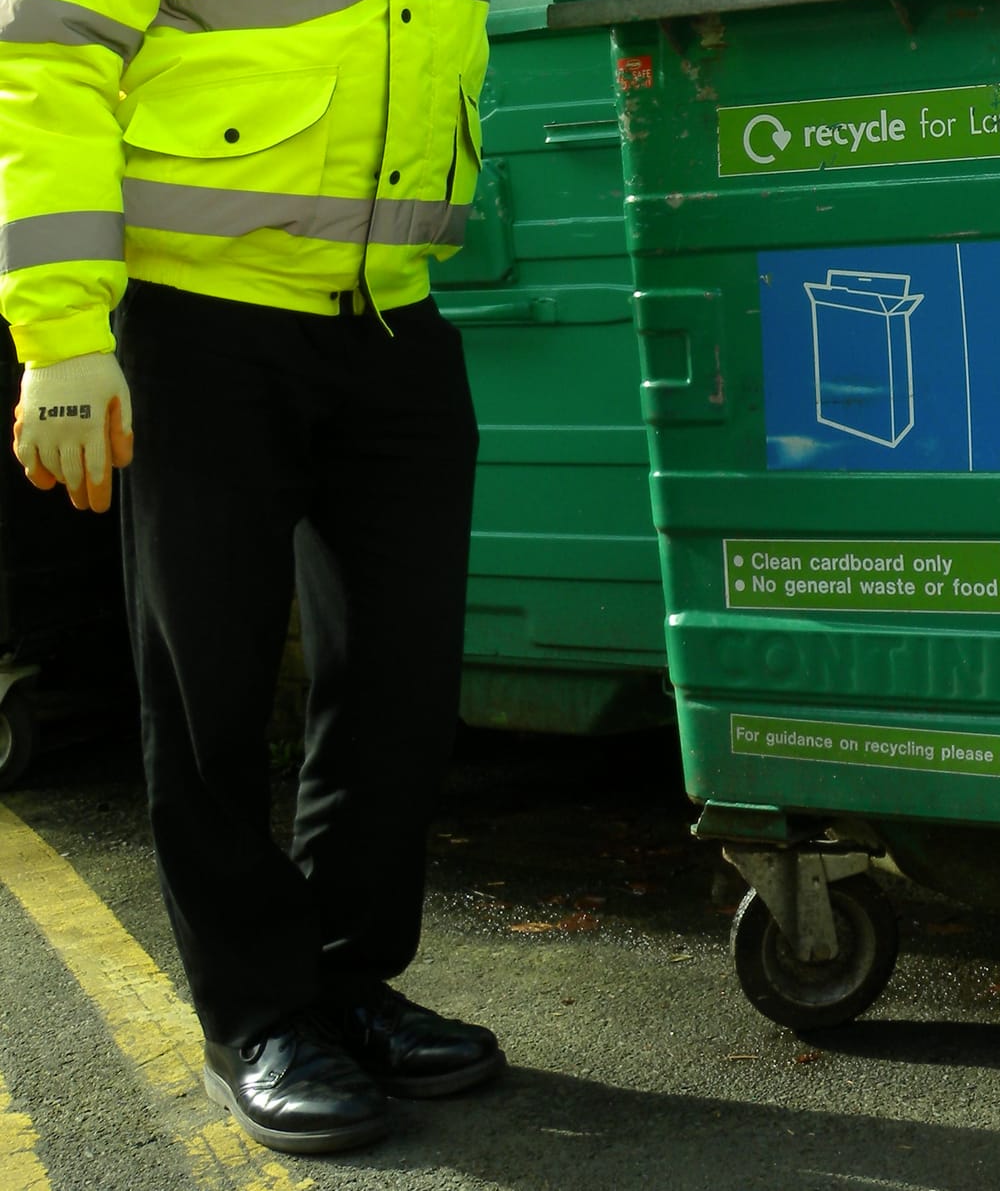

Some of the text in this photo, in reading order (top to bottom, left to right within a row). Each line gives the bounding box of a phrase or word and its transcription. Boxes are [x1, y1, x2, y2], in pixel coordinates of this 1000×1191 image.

[803, 109, 906, 153] recycle
[919, 107, 957, 140] for
[751, 553, 953, 575] Clean cardboard only
[751, 576, 777, 593] No
[784, 577, 852, 596] general
[859, 579, 916, 595] waste
[924, 582, 944, 596] or
[952, 579, 999, 597] food
[735, 727, 760, 742] For
[765, 729, 833, 750] guidance
[839, 738, 859, 751] on
[864, 738, 935, 760] recycling
[940, 745, 994, 763] please
